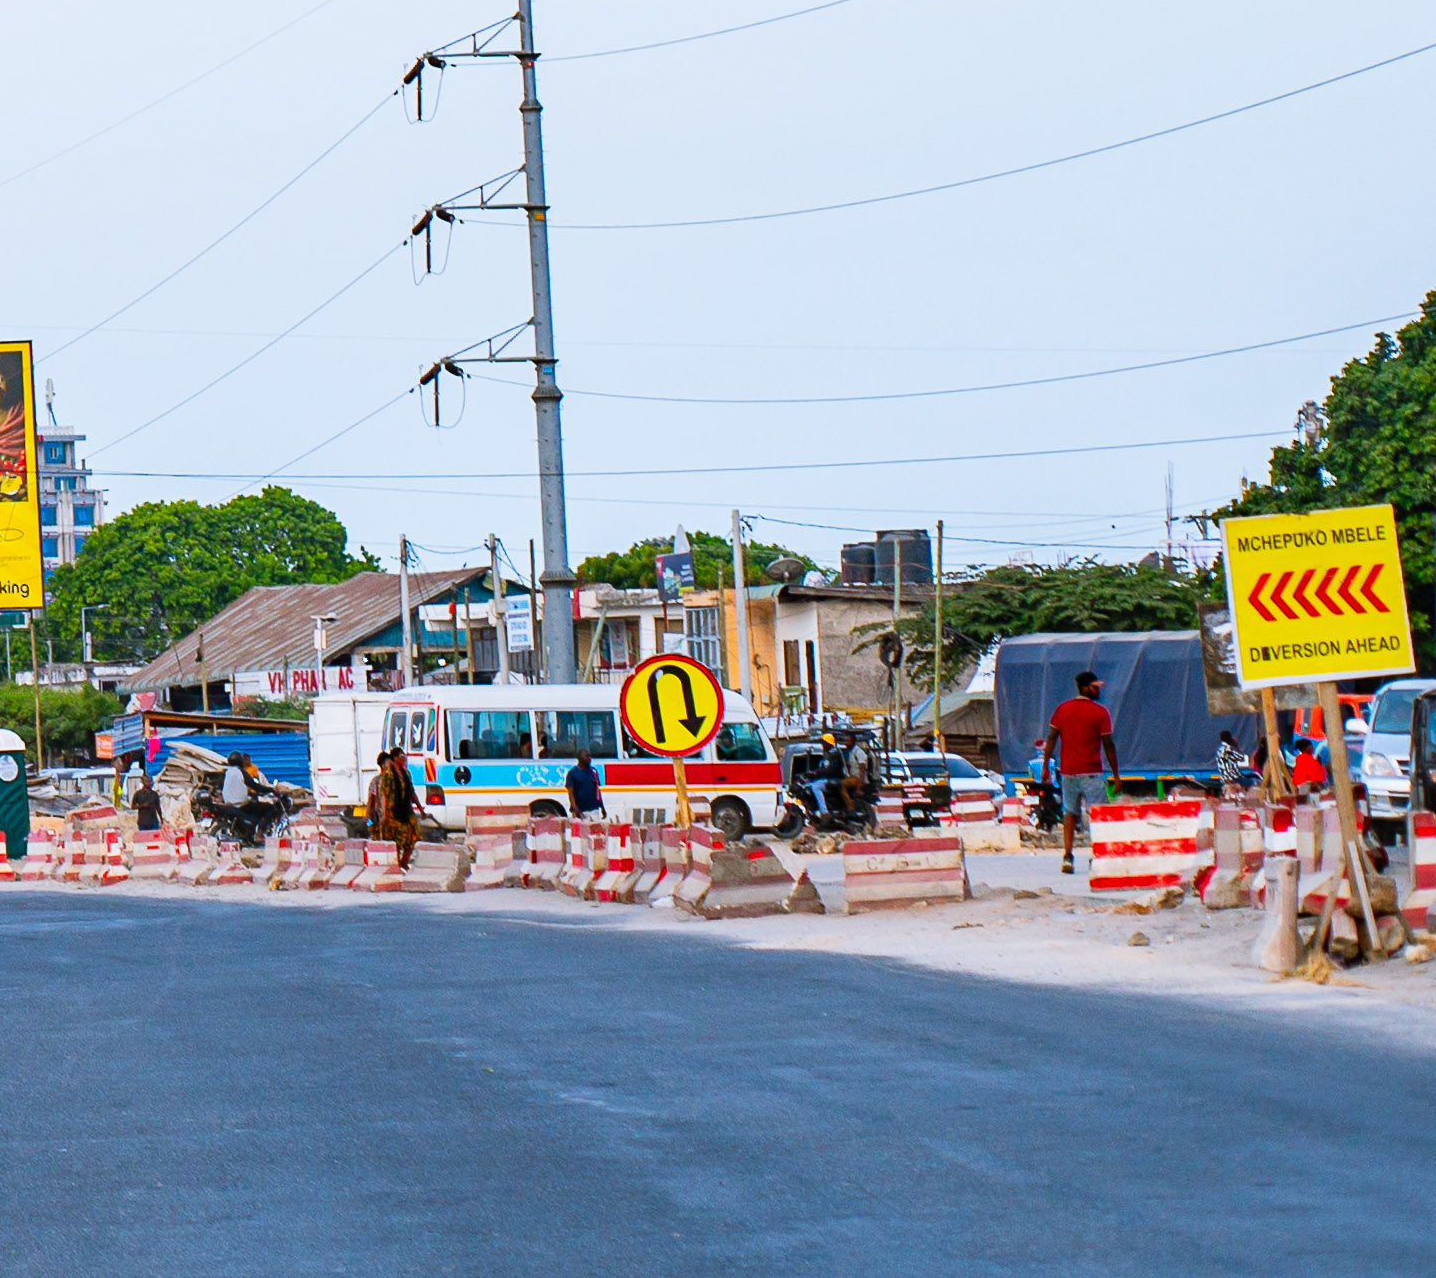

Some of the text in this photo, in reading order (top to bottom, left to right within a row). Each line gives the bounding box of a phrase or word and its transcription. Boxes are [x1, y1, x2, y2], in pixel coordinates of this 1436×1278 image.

[1237, 526, 1386, 552] MCHEPUKO MBELE
[1250, 636, 1400, 662] DVERSION AHEAD
